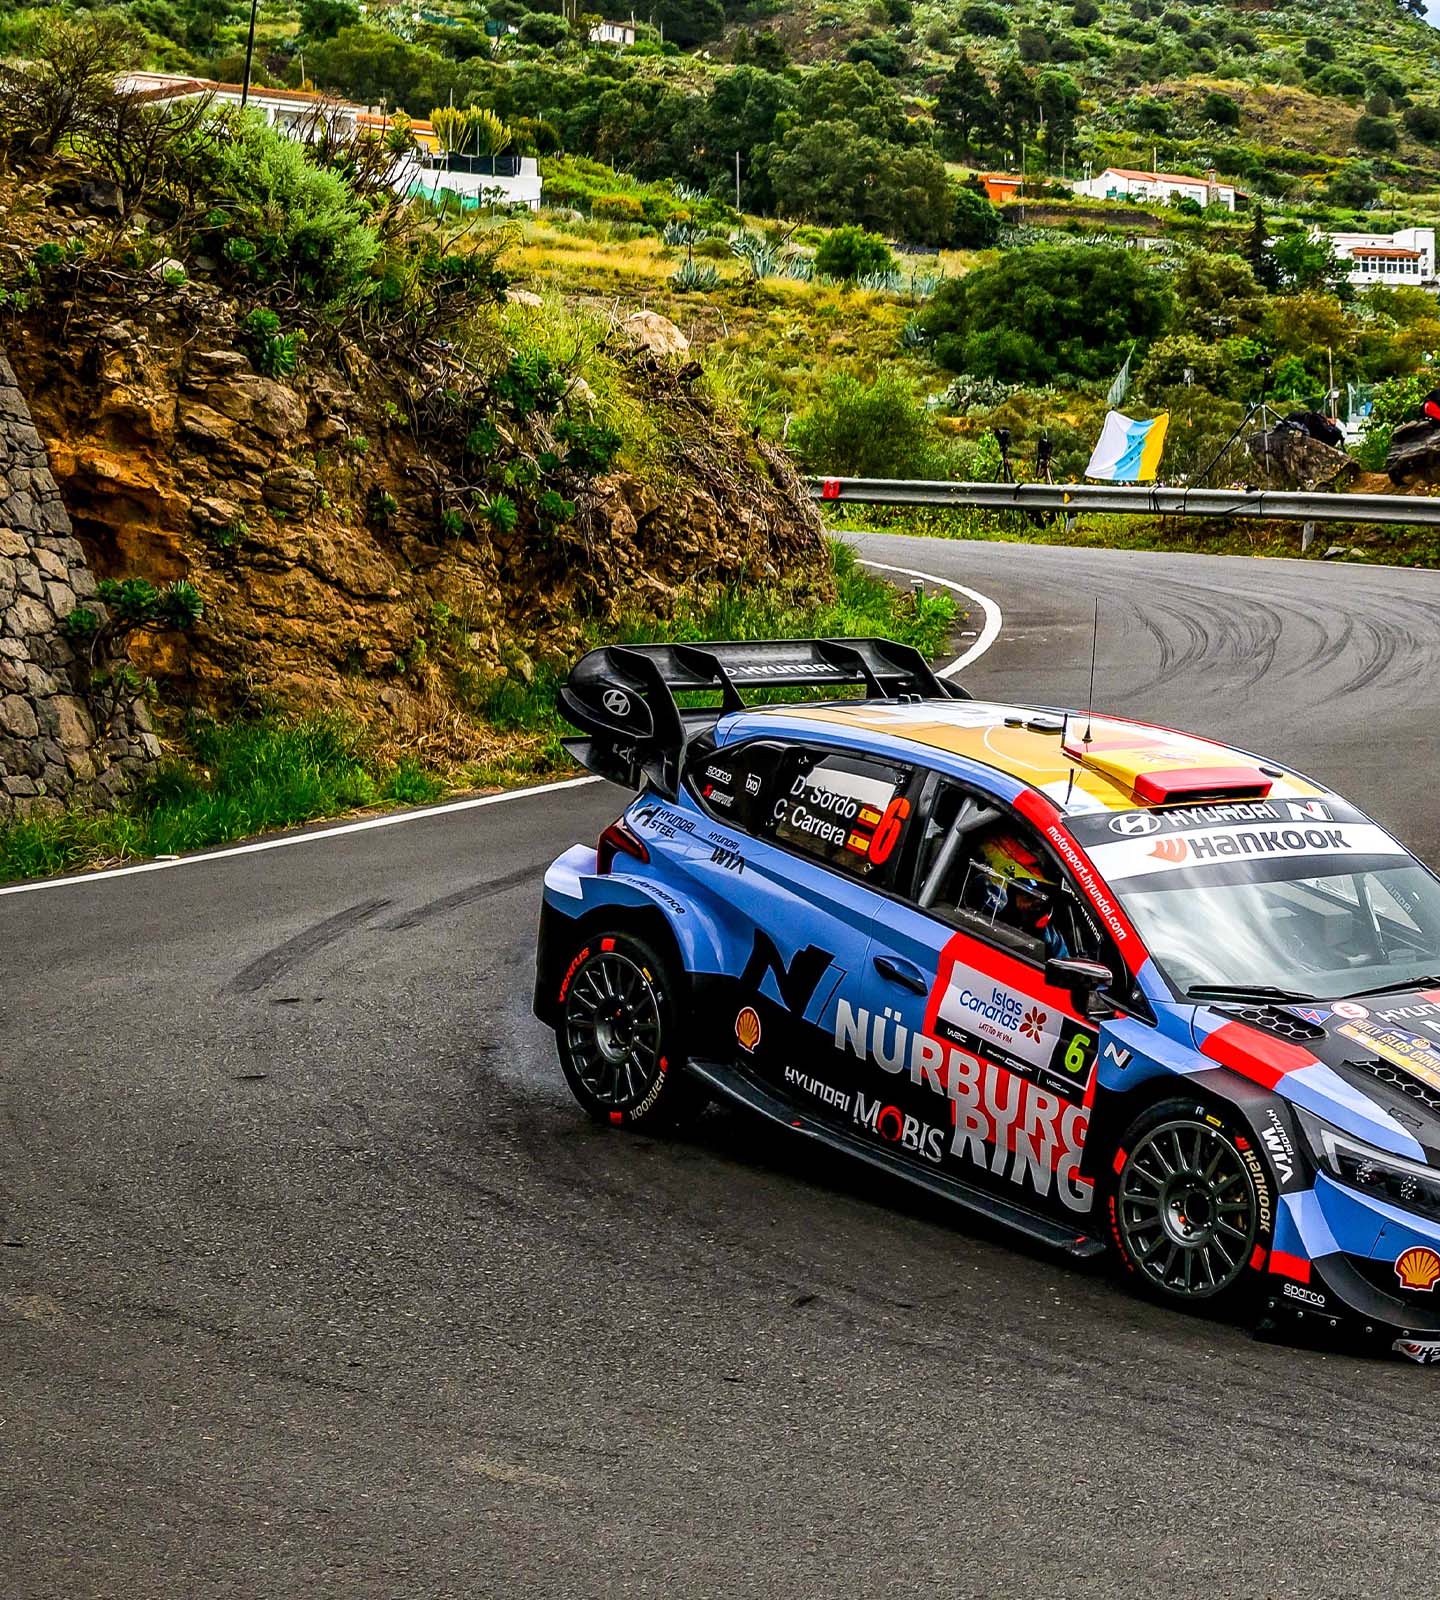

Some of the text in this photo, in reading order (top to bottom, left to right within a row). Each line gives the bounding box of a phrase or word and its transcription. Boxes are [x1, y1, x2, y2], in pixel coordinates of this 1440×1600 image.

[739, 663, 840, 675] HYUNDAI
[706, 765, 732, 783] sparco
[790, 775, 857, 819] D. Sordo
[1163, 803, 1281, 827] HYUNDAI
[649, 820, 678, 839] STEEL
[657, 809, 697, 833] HYUNDAI
[708, 831, 740, 850] HYUNDAI
[773, 798, 846, 847] C. Carrera
[869, 797, 911, 865] 6
[709, 846, 746, 875] WIA
[1047, 825, 1127, 940] motorsport.hyundai.com
[959, 990, 1020, 1031] Canarias
[991, 987, 1023, 1015] Islas
[946, 1027, 968, 1043] WRC
[1064, 1033, 1091, 1073] 6
[1350, 1019, 1382, 1037] RALLY
[1379, 1031, 1414, 1053] ISLAS
[784, 1065, 850, 1111] HYUNDAI
[834, 998, 1092, 1155] NÜRBURG
[853, 1091, 945, 1162] MOBIS
[1266, 1109, 1295, 1156] HYUNDAI
[951, 1101, 1094, 1212] RING
[1261, 1127, 1294, 1184] WIA
[1283, 1283, 1326, 1304] sparco
